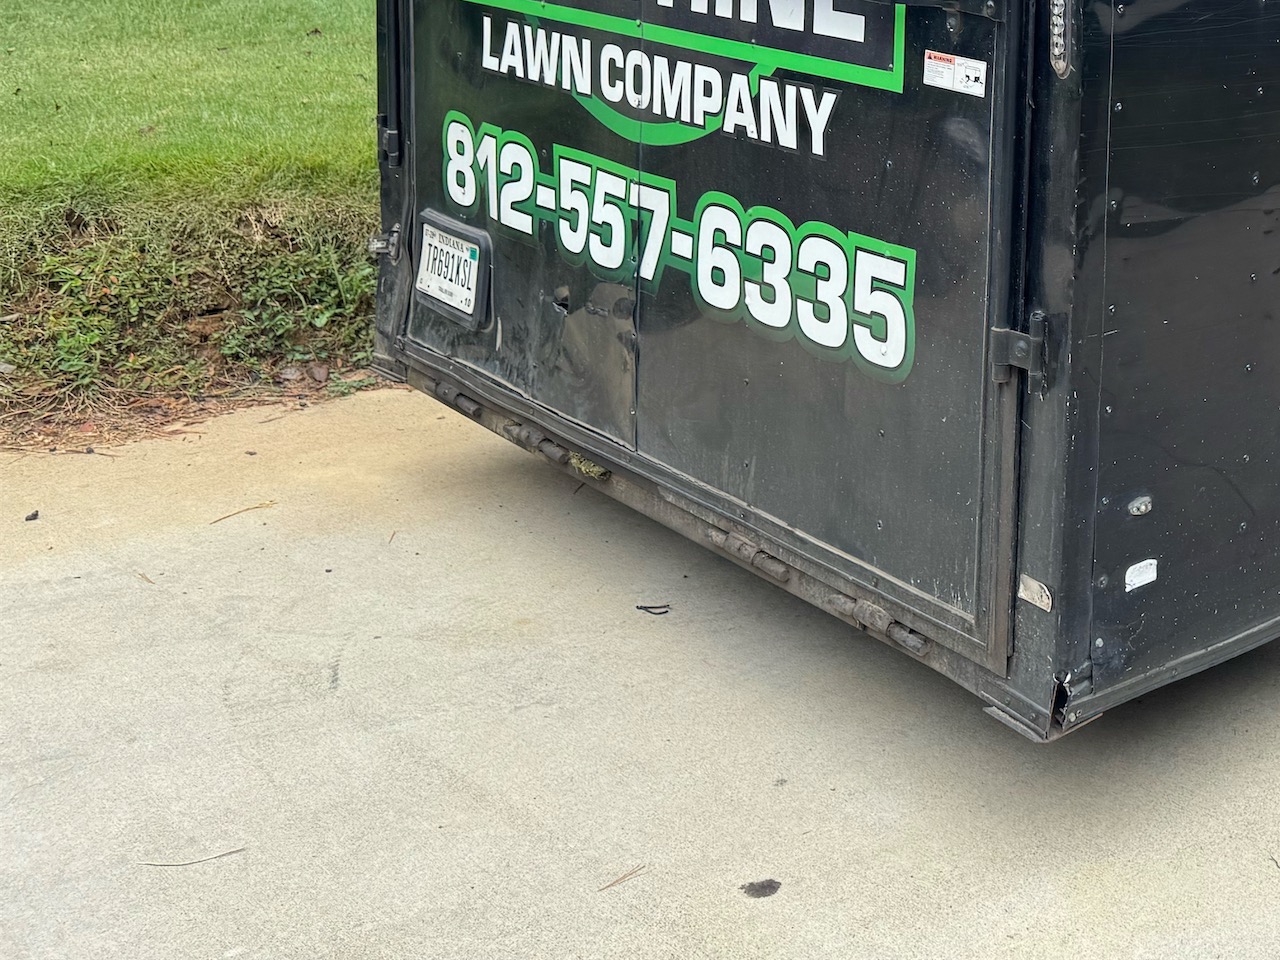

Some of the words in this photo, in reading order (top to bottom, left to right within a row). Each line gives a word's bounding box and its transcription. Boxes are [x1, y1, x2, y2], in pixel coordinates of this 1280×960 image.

[481, 15, 592, 96] LAWN
[600, 43, 837, 157] COMPANY
[438, 233, 465, 253] INDIANA
[445, 121, 907, 369] 812-557-6335
